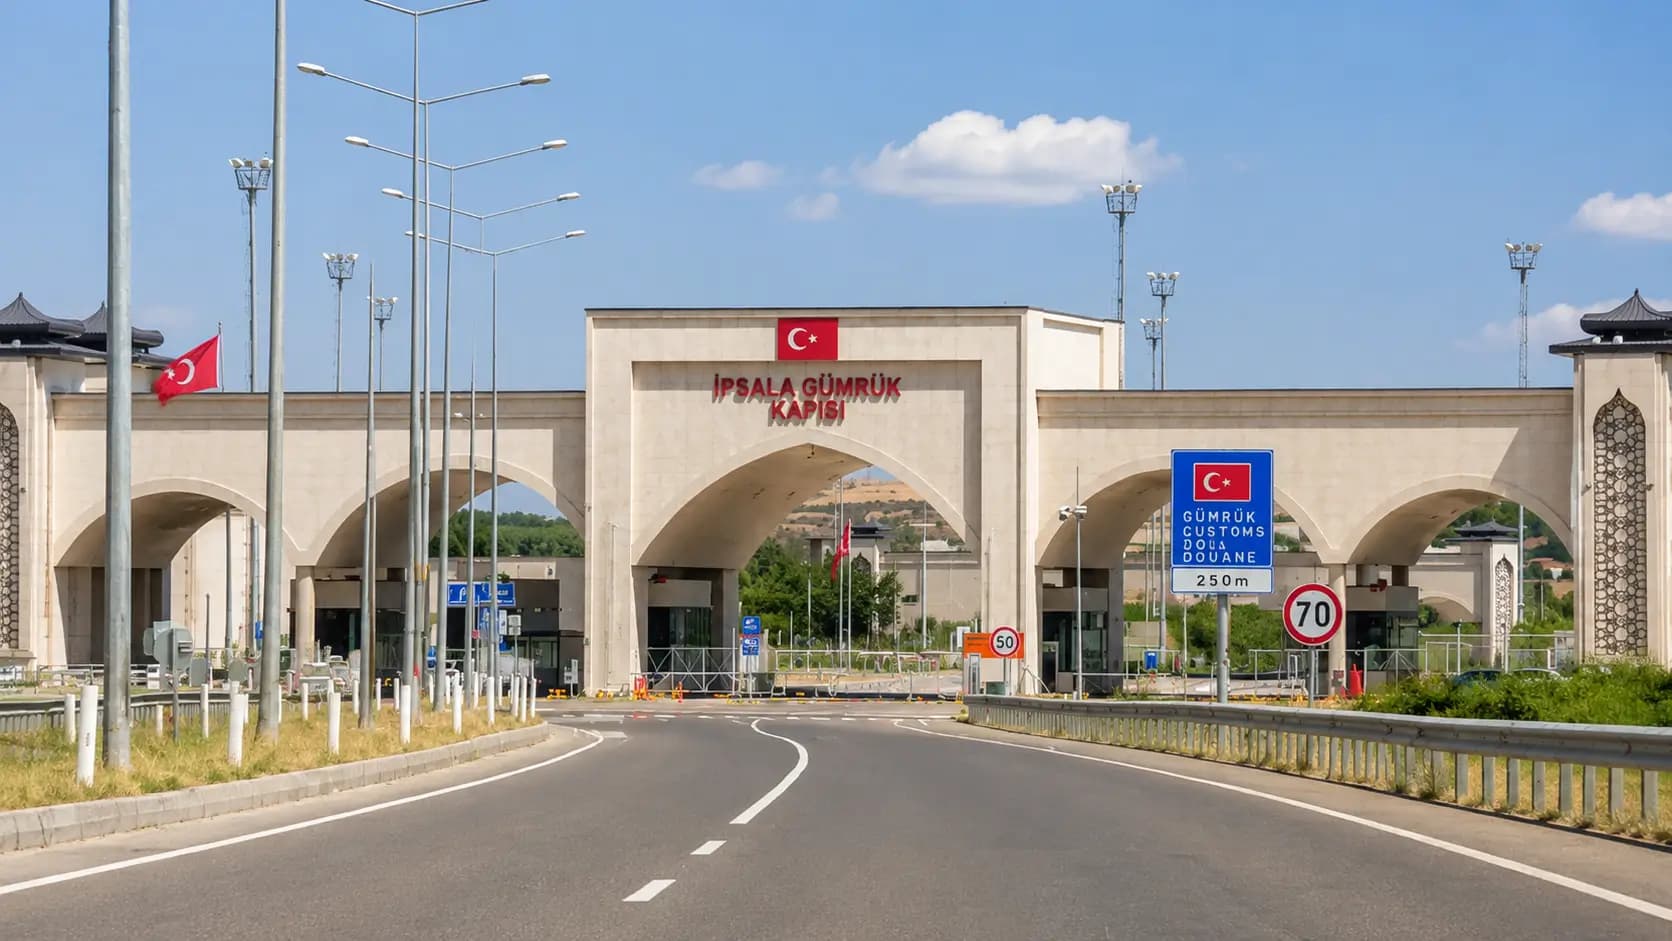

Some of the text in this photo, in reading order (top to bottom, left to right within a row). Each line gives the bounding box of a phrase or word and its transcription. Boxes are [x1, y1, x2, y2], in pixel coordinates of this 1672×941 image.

[713, 373, 901, 397] İPSALA GÜMRÜK
[771, 400, 845, 420] KAPISI
[1183, 507, 1255, 522] GÜMRÜK
[1183, 526, 1265, 537] CUSTOMS
[1183, 552, 1256, 563] DOUANE
[1296, 601, 1330, 627] 70
[996, 635, 1013, 648] 50
